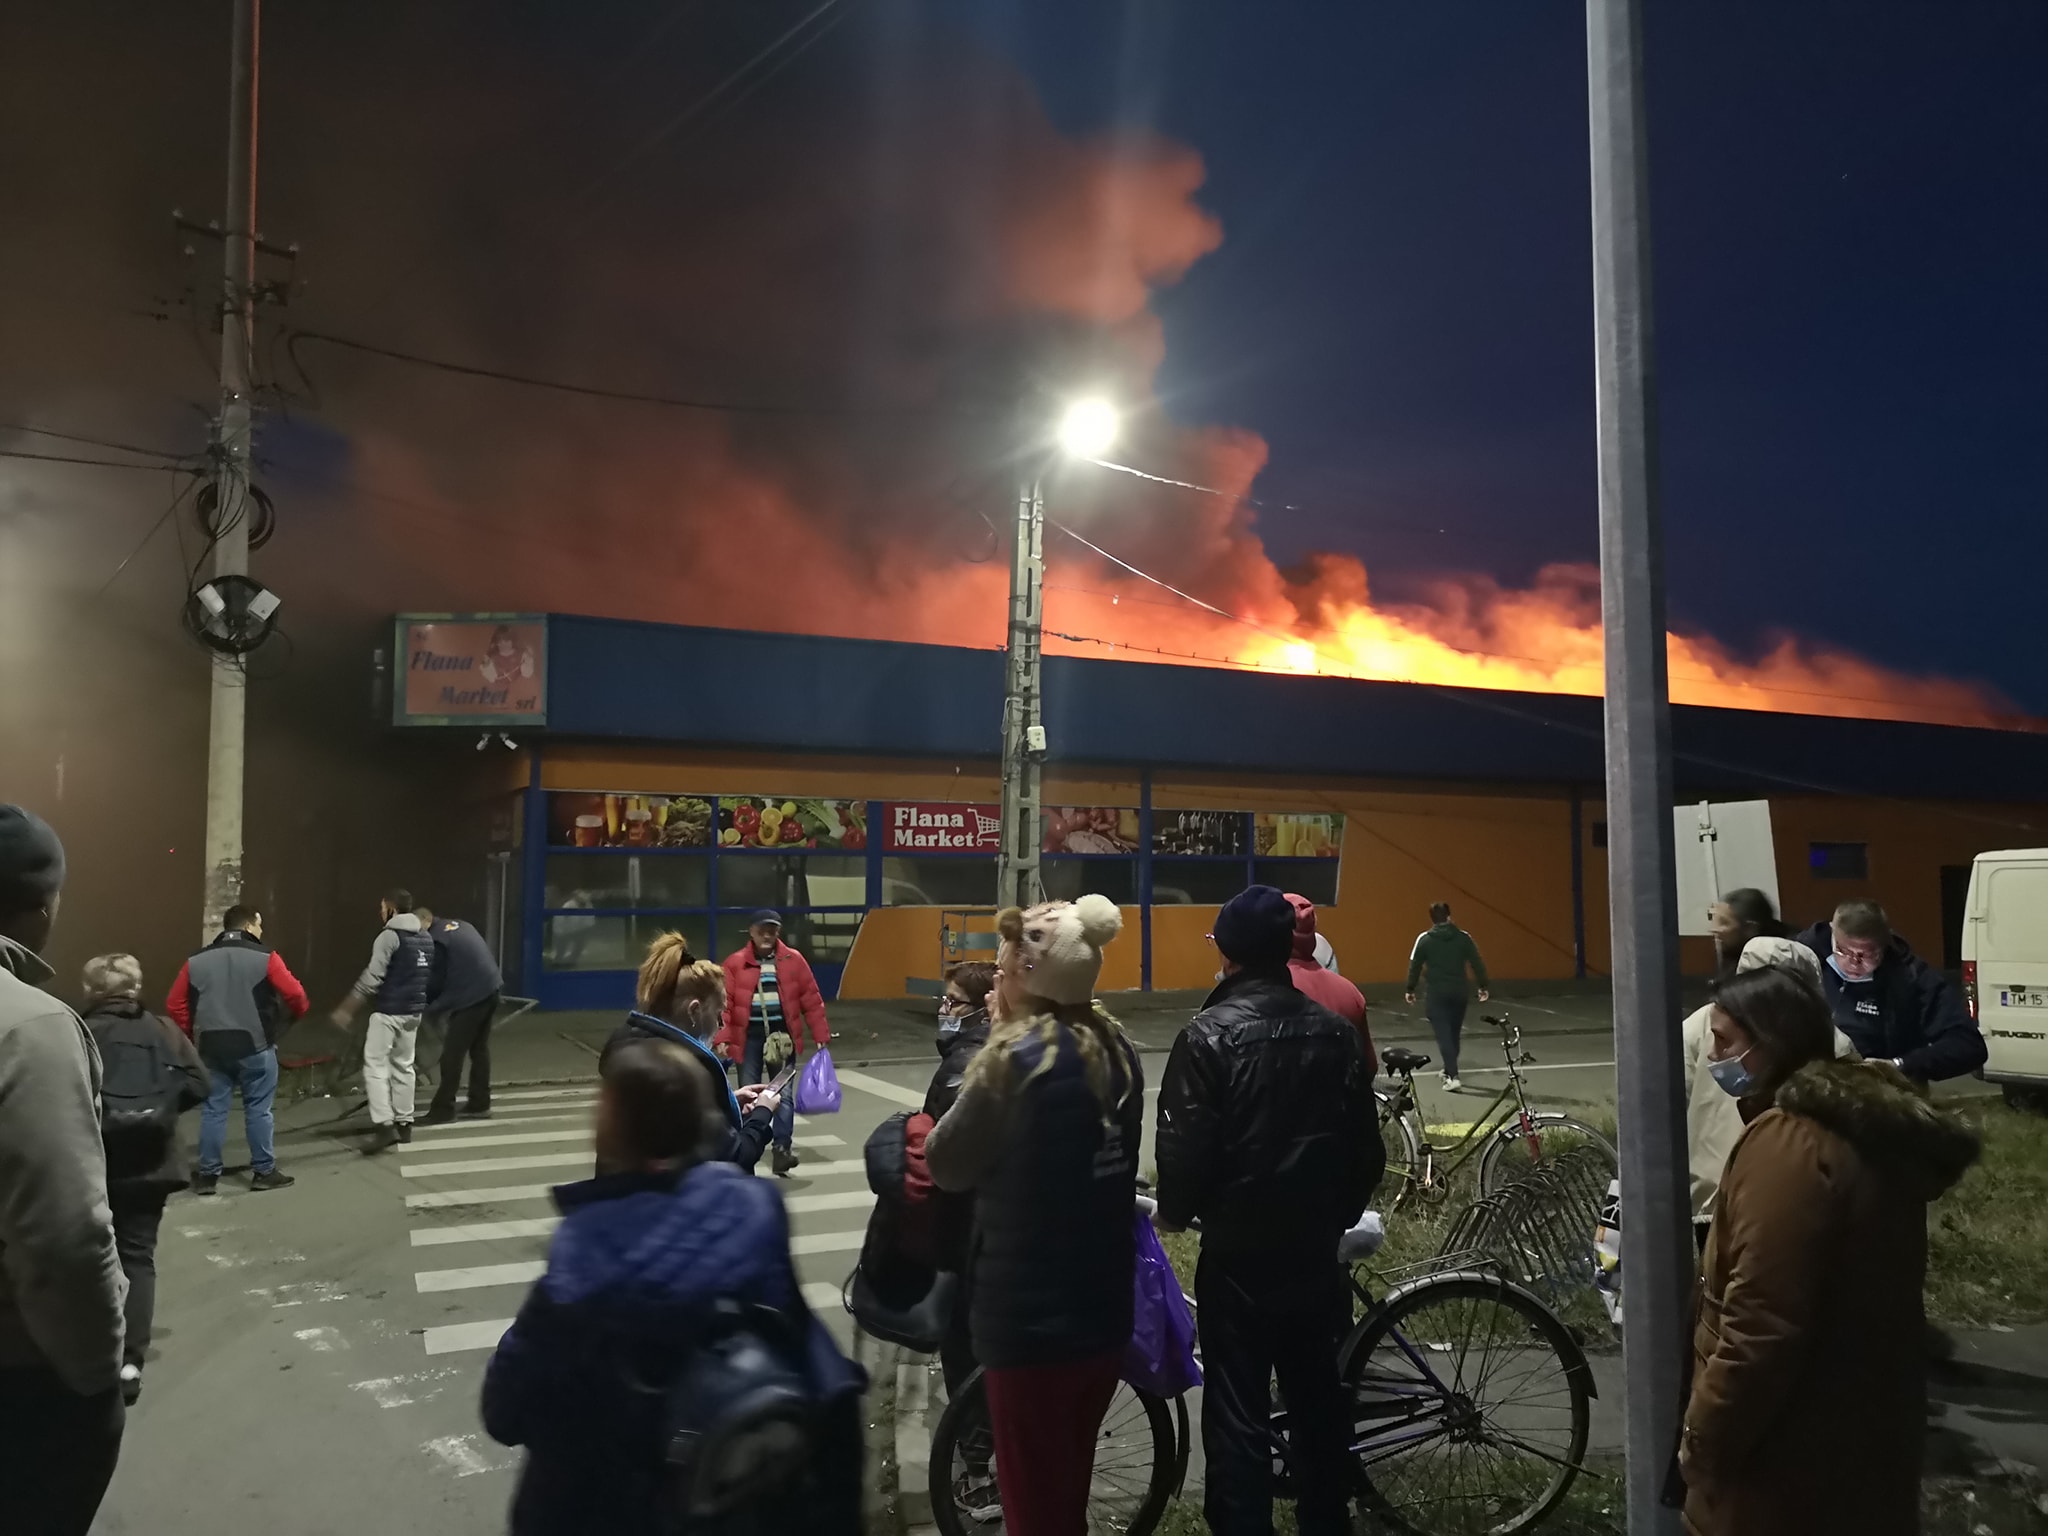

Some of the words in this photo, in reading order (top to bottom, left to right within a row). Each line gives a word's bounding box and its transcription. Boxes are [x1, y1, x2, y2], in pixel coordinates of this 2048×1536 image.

[411, 651, 474, 671] Flana
[440, 686, 509, 705] Market
[894, 807, 965, 828] Flana
[893, 829, 975, 848] Market
[2010, 993, 2027, 1006] TM
[2030, 994, 2043, 1006] 15
[1990, 1029, 2046, 1040] PEUGEOT
